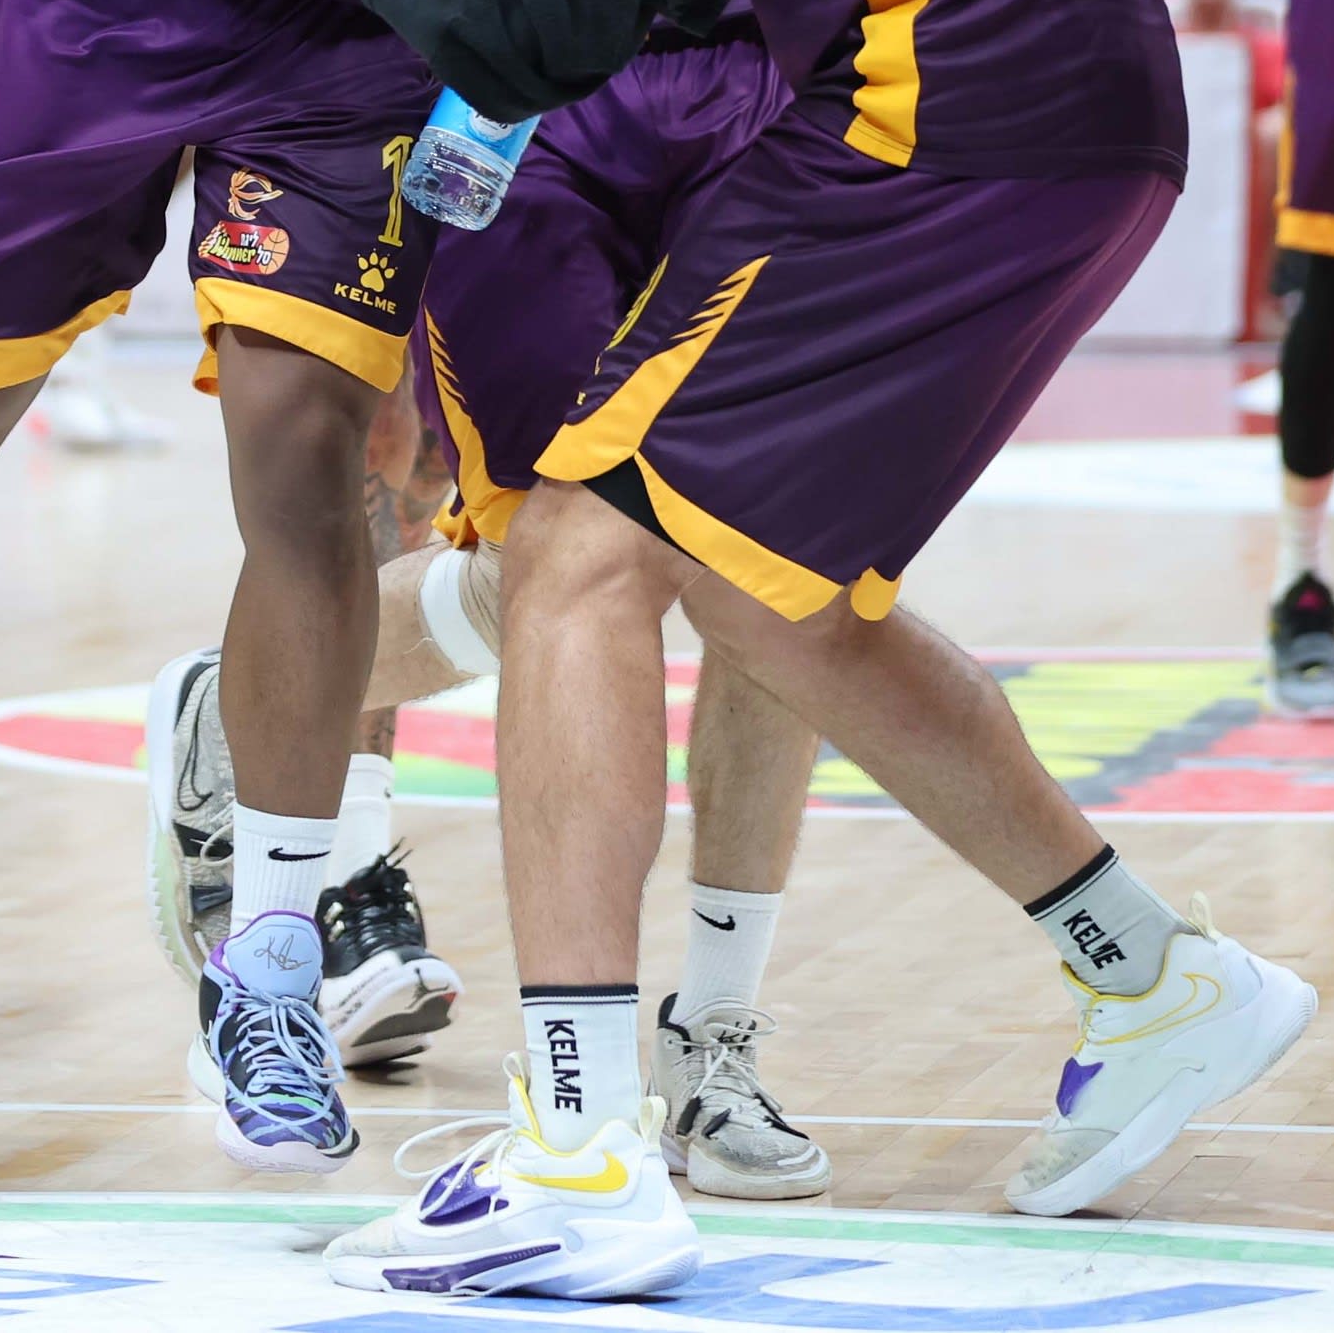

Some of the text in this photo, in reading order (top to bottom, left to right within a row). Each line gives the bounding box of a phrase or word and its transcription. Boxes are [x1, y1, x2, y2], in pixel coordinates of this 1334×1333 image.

[377, 135, 415, 247] 1
[333, 282, 397, 315] KELME
[543, 1018, 583, 1115] KELME
